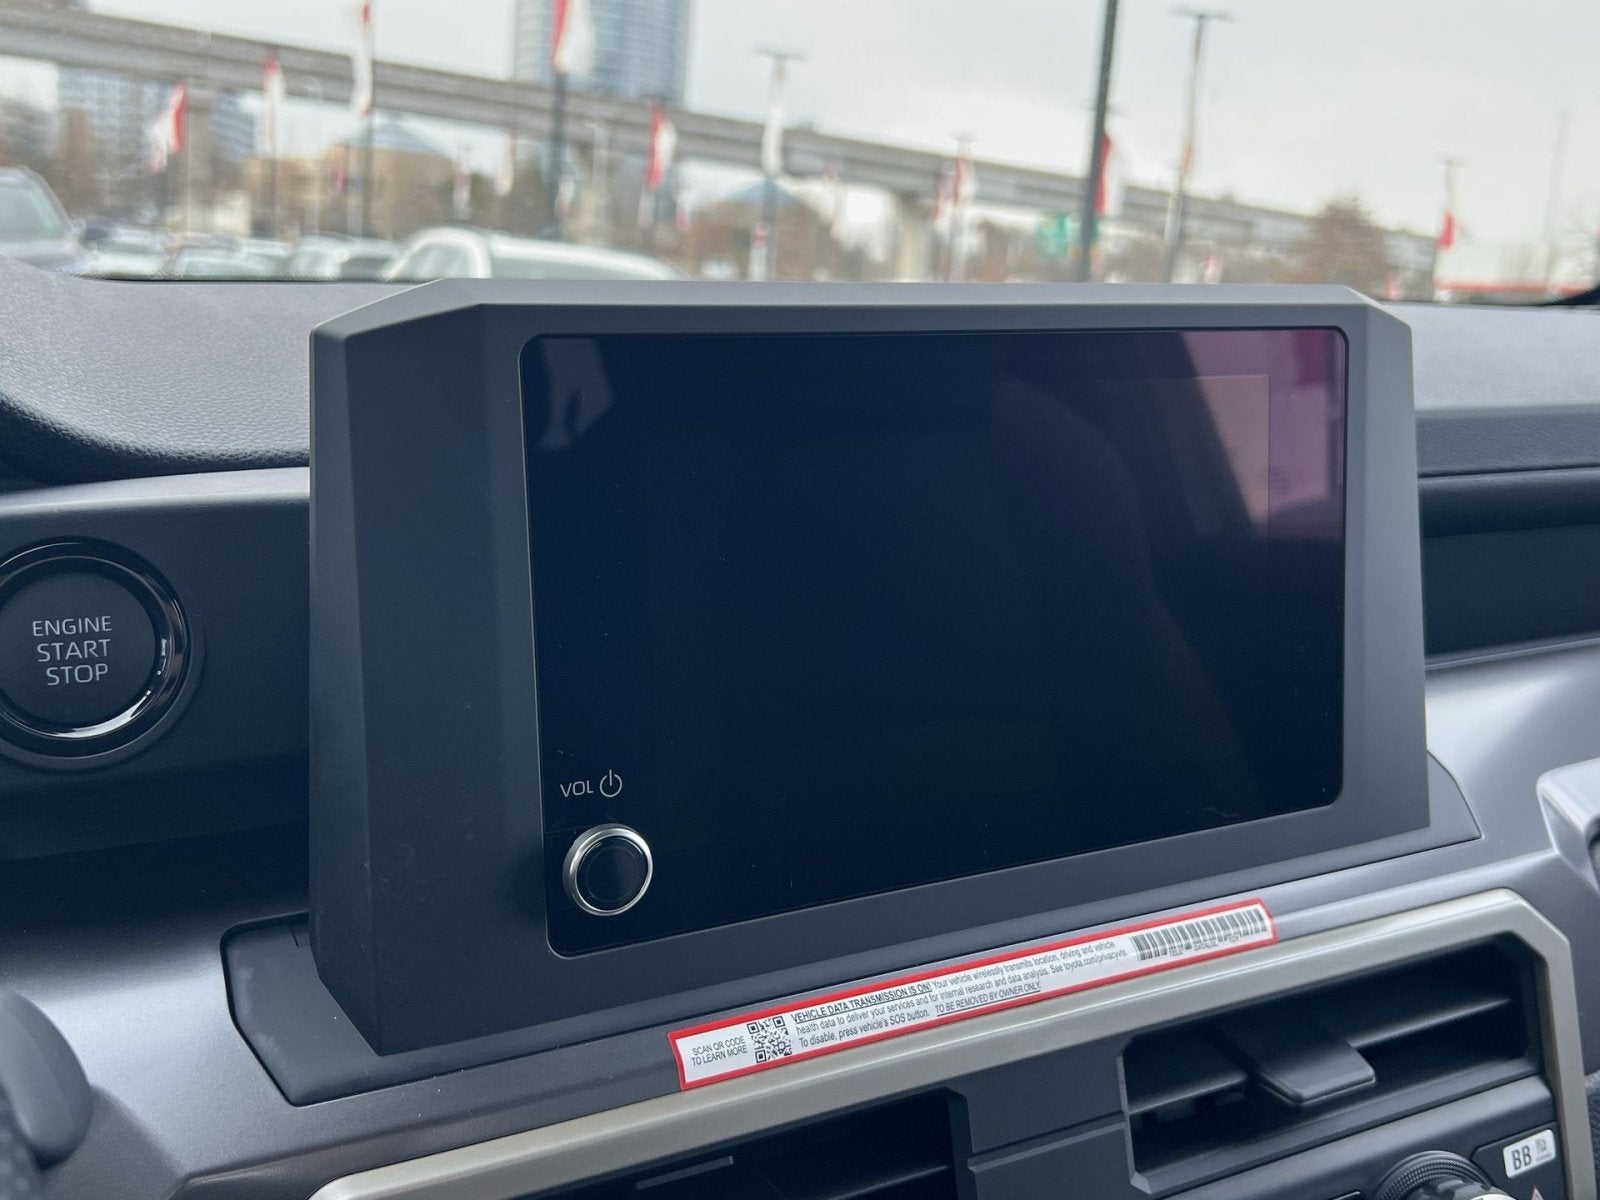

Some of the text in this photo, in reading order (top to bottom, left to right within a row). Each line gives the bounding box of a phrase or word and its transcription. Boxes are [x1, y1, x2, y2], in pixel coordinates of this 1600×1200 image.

[32, 616, 112, 636] ENGINE
[37, 639, 111, 662] START
[46, 663, 108, 686] STOP
[560, 780, 594, 797] VOL
[791, 1007, 828, 1023] VEHICLE
[828, 1003, 849, 1016] DATA
[849, 989, 908, 1010] TRANSMISSION
[908, 985, 917, 995] IS
[933, 979, 948, 990] Your
[949, 973, 972, 984] vehicle
[1081, 944, 1093, 954] and
[796, 1021, 819, 1035] health
[820, 1017, 836, 1029] data
[836, 1015, 845, 1025] to
[846, 1010, 869, 1023] deliver
[871, 1006, 886, 1020] your
[887, 999, 915, 1013] services
[916, 995, 929, 1006] and
[929, 992, 938, 1003] for
[940, 987, 963, 1000] internal
[965, 981, 994, 994] research
[995, 977, 1007, 988] and
[1007, 973, 1022, 984] data
[1050, 964, 1063, 973] See
[799, 1038, 809, 1048] To
[838, 1027, 858, 1040] press
[859, 1018, 889, 1033] vehicle's
[889, 1013, 906, 1025] SOS
[935, 1003, 945, 1014] TO
[945, 1000, 955, 1011] BE
[956, 993, 989, 1009] REMOVED
[989, 990, 998, 1000] BY
[998, 985, 1024, 998] OWNER
[691, 1045, 748, 1066] TO LEARN MORE
[692, 1036, 745, 1056] SCAN QR CODE
[1511, 1145, 1532, 1170] BB
